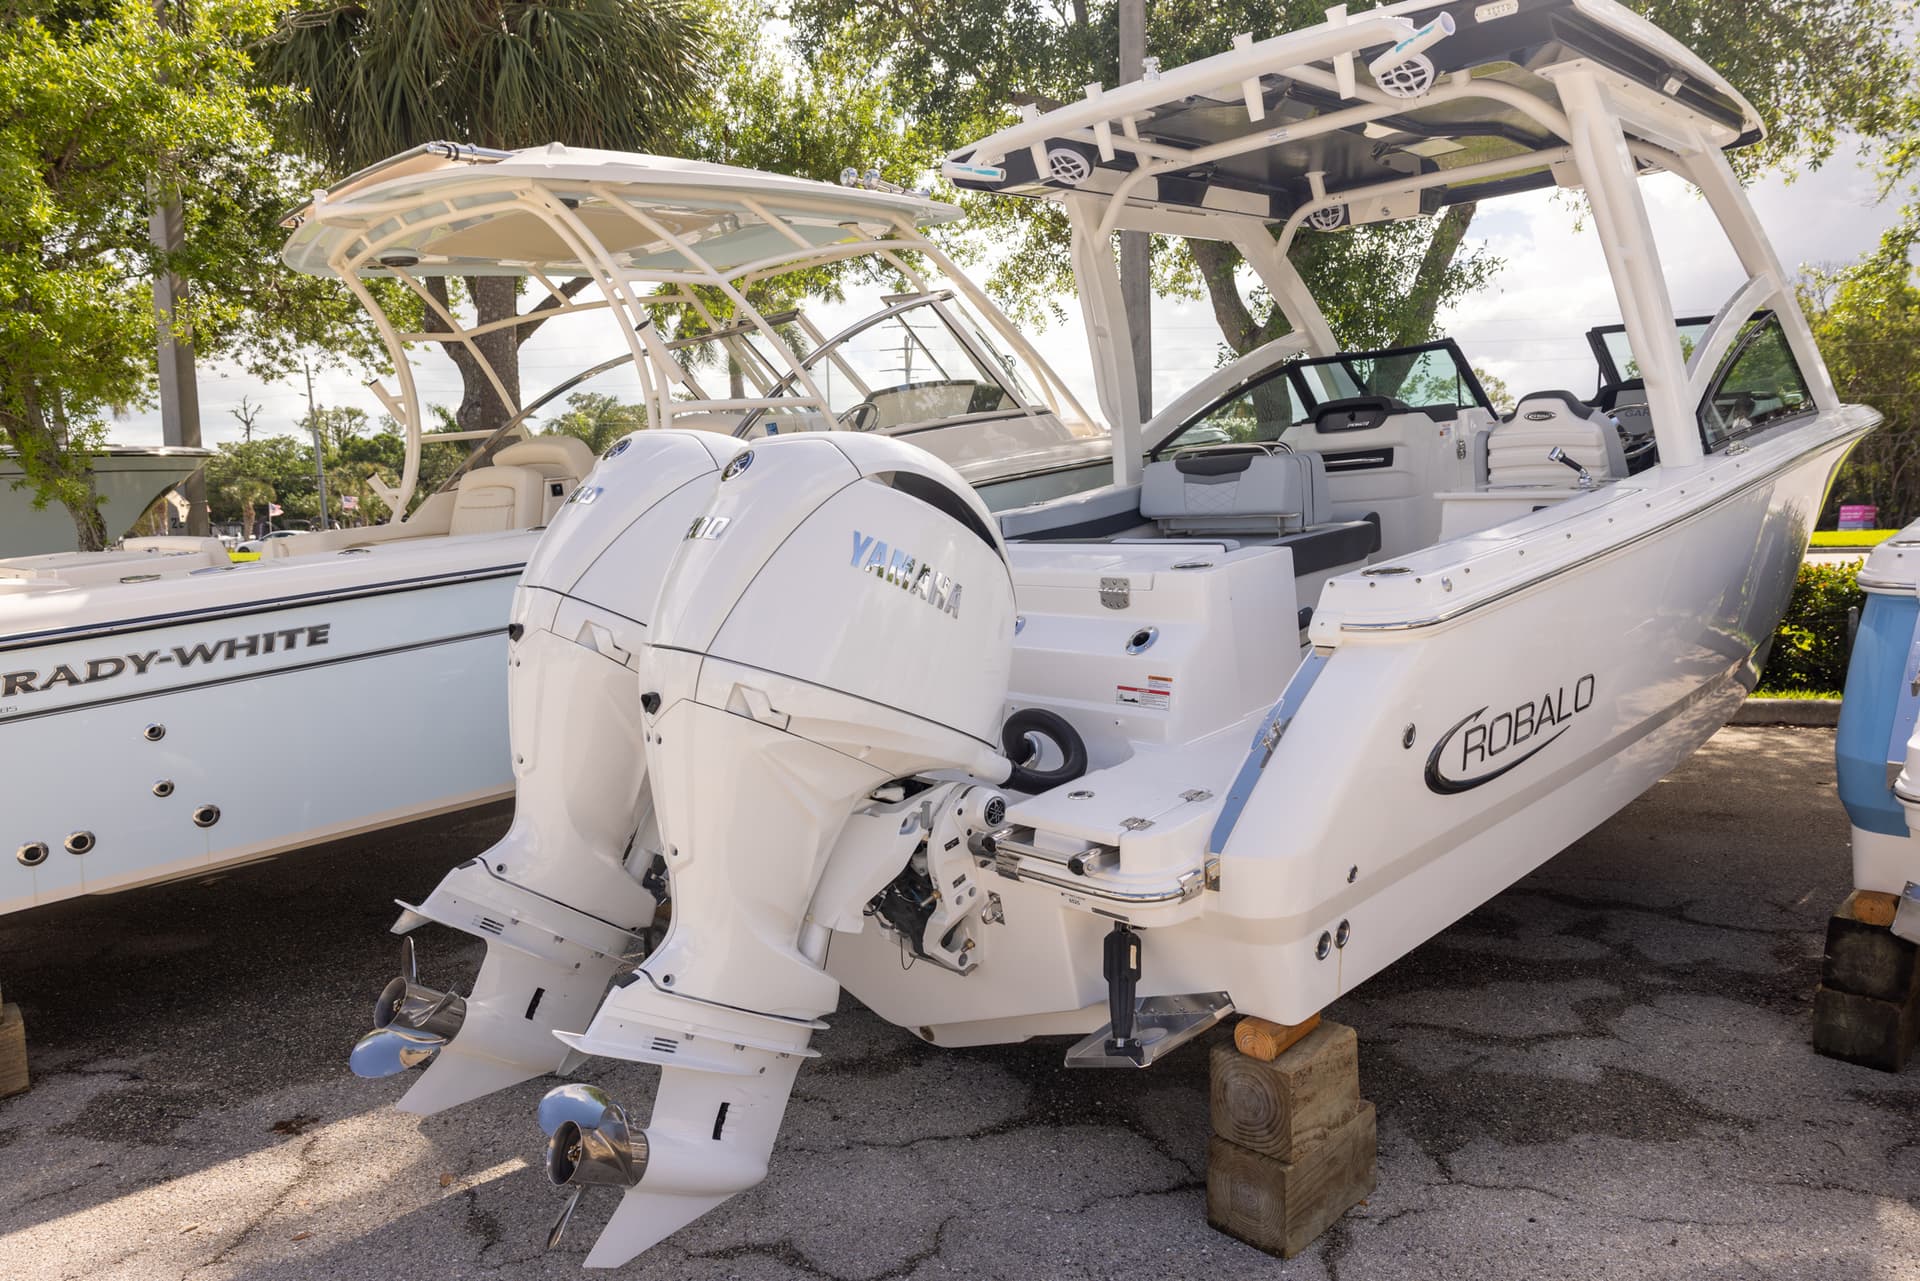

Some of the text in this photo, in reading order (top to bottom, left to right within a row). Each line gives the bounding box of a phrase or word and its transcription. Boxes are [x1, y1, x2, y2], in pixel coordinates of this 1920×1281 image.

[850, 530, 962, 620] YAMAHA
[1, 623, 331, 698] RADY-WHITE
[1462, 673, 1595, 771] ROBALO
